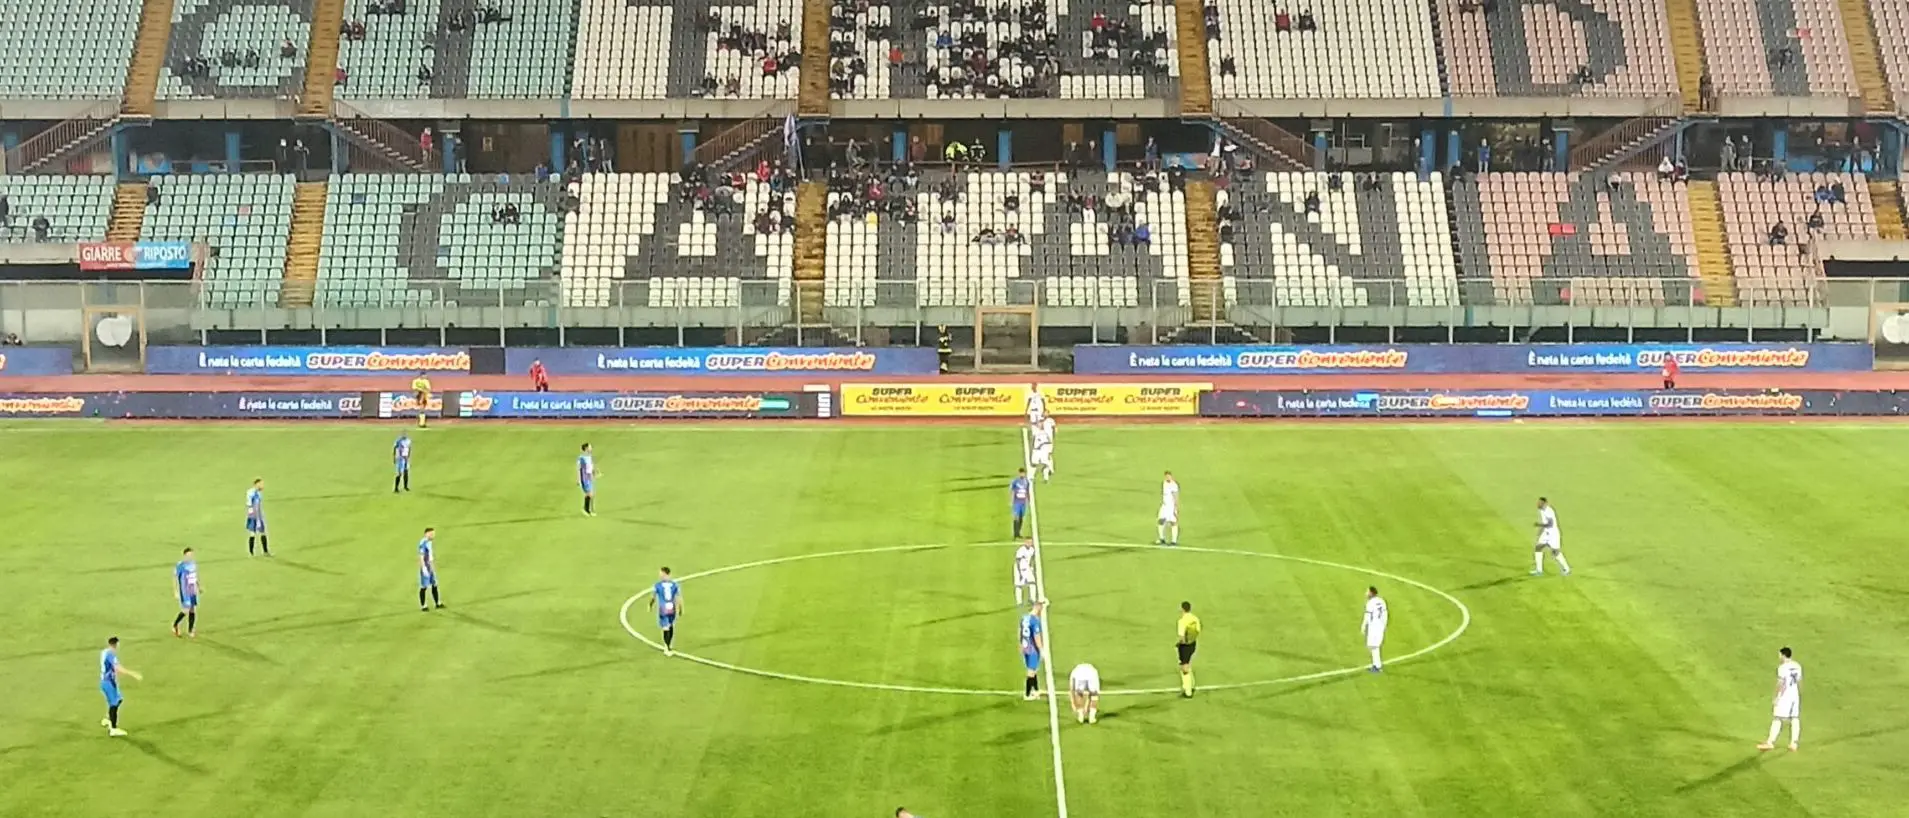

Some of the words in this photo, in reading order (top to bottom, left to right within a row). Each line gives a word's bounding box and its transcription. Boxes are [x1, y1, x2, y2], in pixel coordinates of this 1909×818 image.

[82, 246, 121, 261] GIARRE
[144, 246, 187, 261] RIPOSTO
[398, 173, 1698, 307] CATANIA
